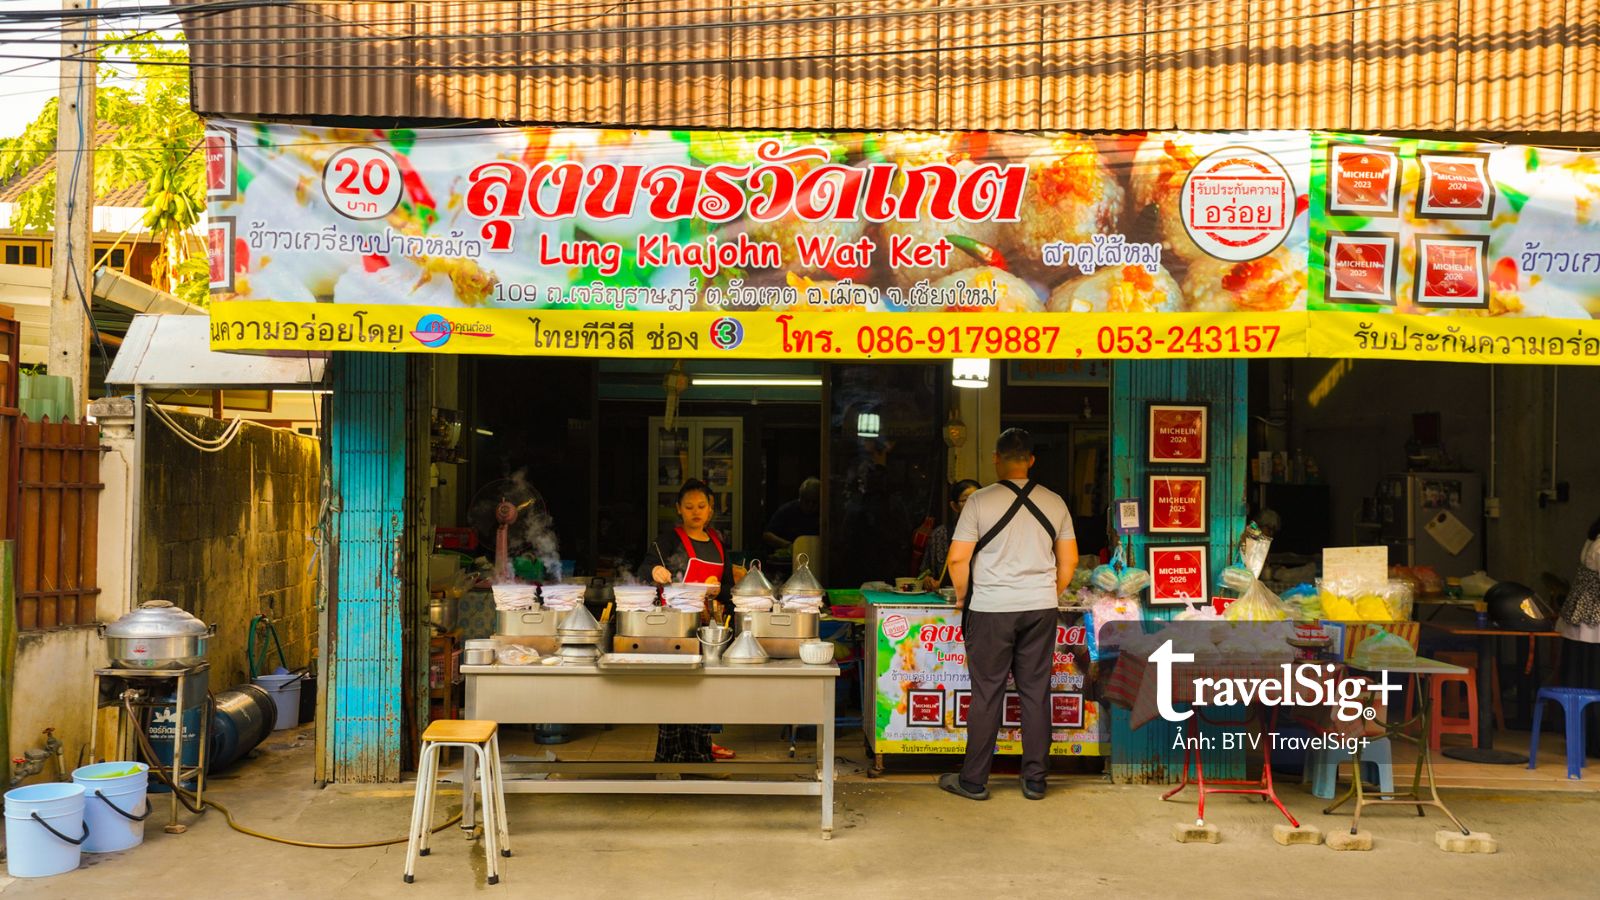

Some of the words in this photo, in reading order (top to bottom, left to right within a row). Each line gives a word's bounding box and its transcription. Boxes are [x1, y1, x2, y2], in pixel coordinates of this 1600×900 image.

[335, 157, 390, 196] 20
[1343, 170, 1384, 179] MICHELIN
[1437, 173, 1477, 183] MICHELIN
[1197, 182, 1279, 195] รับประกันความ
[1353, 180, 1371, 188] 2023
[1447, 182, 1467, 190] 2024
[466, 140, 1028, 249] ลุงขจรวัดเกต
[347, 201, 377, 213] บาท
[1206, 197, 1271, 223] อร่อย
[249, 221, 481, 257] ข้าวเกรียบปากหม้อ
[540, 234, 620, 274] Lung
[638, 234, 779, 275] Khajohn
[797, 235, 875, 266] Wat
[891, 235, 952, 266] Ket
[1044, 235, 1160, 272] สาคูไส้หมู
[1340, 260, 1377, 269] MICHELIN
[1433, 263, 1473, 272] MICHELIN
[1350, 269, 1367, 277] 2025
[1444, 273, 1463, 281] 2026
[494, 283, 537, 302] 109
[807, 278, 880, 305] อ.เมือง
[887, 279, 997, 305] จ.เชียงใหม่
[528, 317, 634, 350] ไทยทีวีสี
[646, 323, 699, 350] ช่อง
[713, 318, 740, 348] 3
[776, 314, 842, 353] โทร.
[857, 325, 1061, 354] 086-9179887
[1097, 325, 1280, 353] 053-243157
[1159, 427, 1197, 436] MICHELIN
[1169, 505, 1186, 513] 2025
[1159, 567, 1197, 575] MICHELIN
[937, 651, 964, 664] Lung
[1052, 652, 1074, 663] Ket
